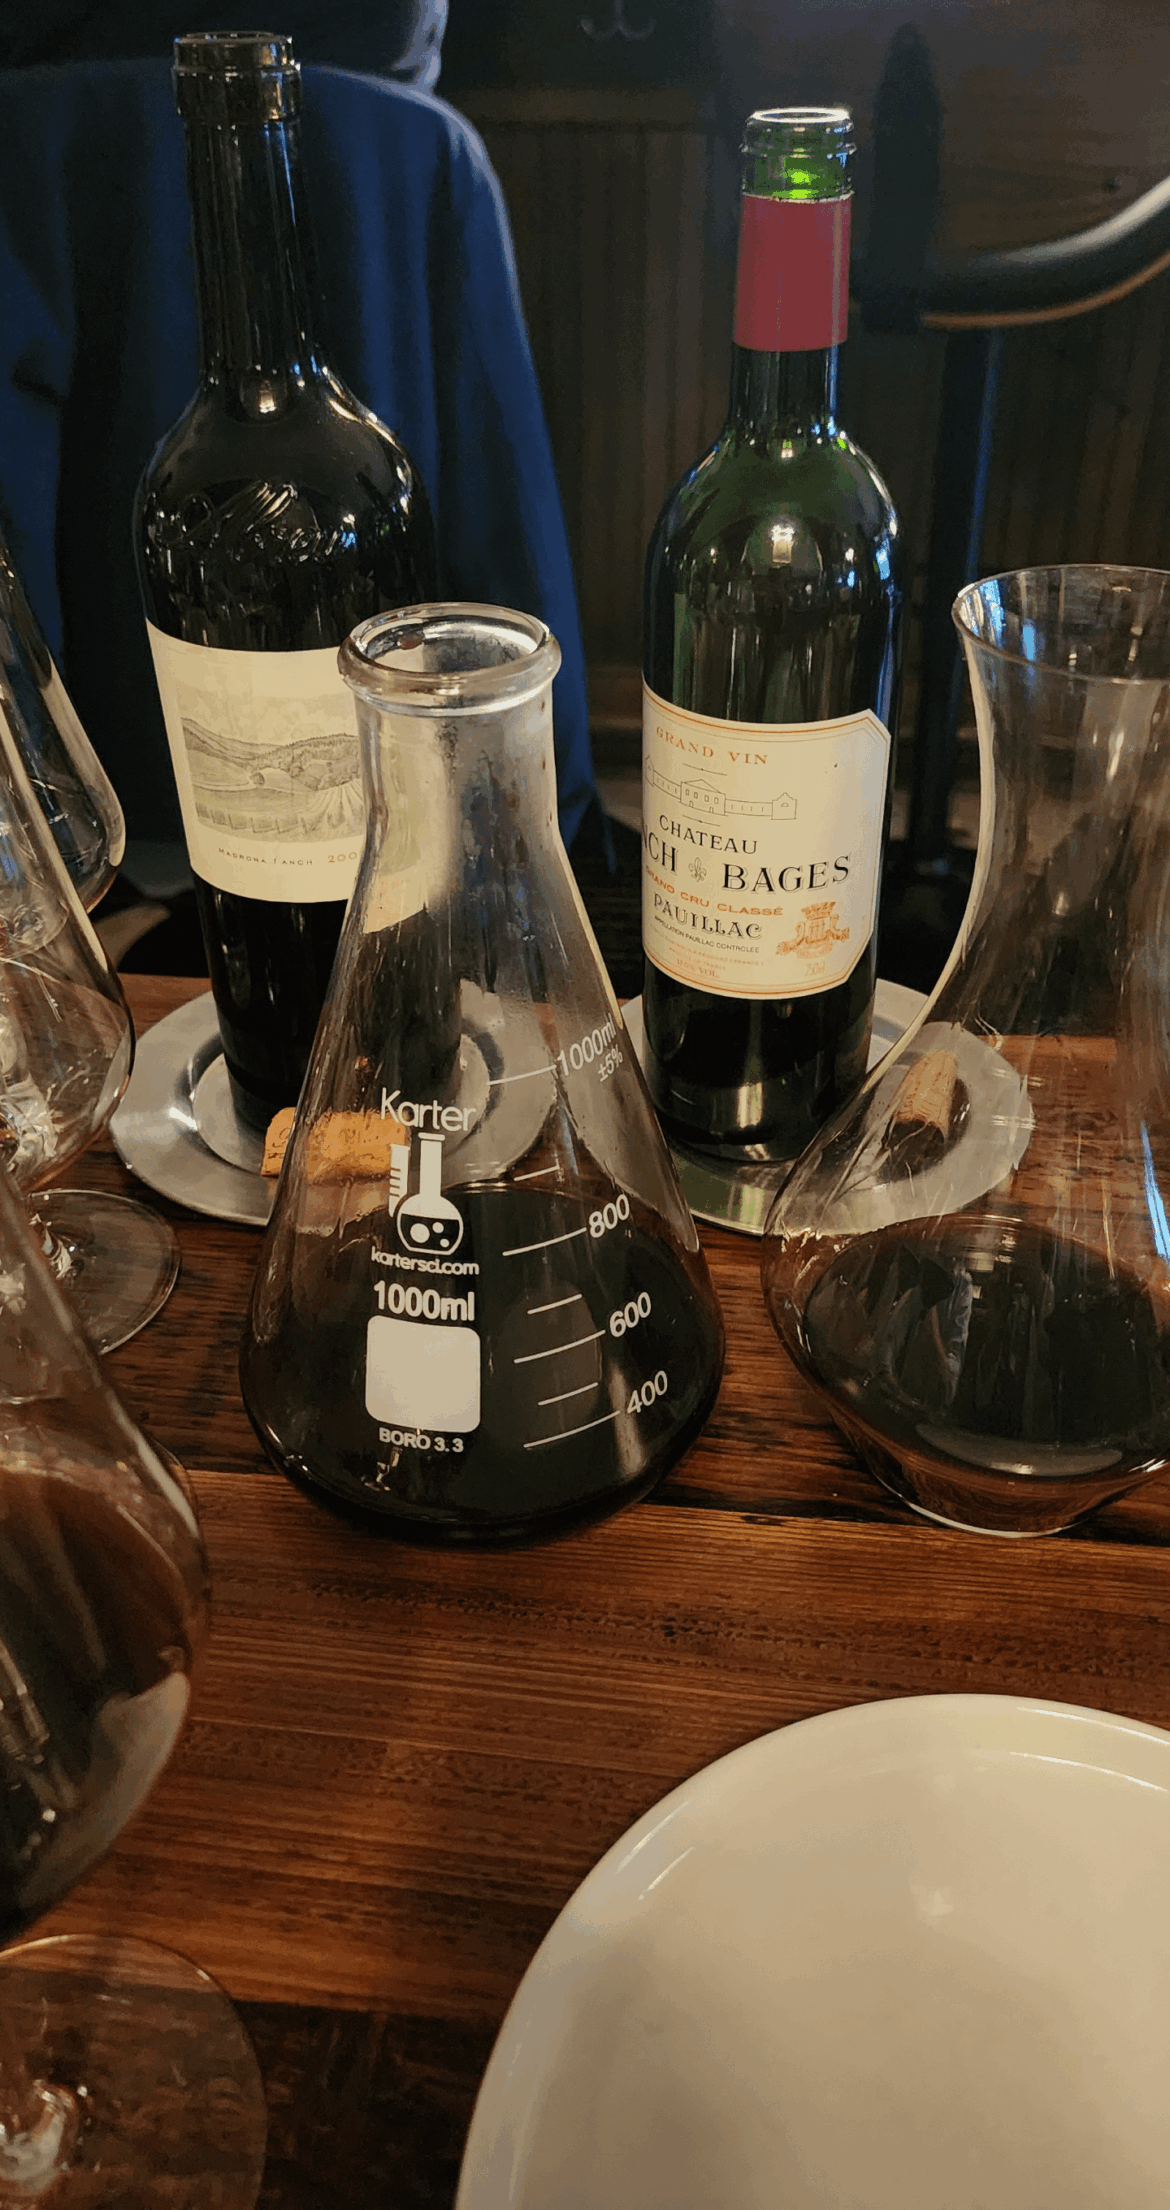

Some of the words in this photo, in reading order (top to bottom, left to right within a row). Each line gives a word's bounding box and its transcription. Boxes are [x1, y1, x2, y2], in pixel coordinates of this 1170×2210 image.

[656, 725, 714, 758] GRAND
[728, 750, 768, 766] VIN
[659, 814, 758, 855] CHATEAU
[327, 851, 361, 864] 200
[722, 854, 852, 893] BAGES
[654, 893, 763, 940] PAUILLAC
[680, 891, 710, 908] CRU
[557, 1012, 617, 1077] 1000ml
[598, 1044, 624, 1083] ±5%
[380, 1087, 478, 1133] Karter
[589, 1194, 631, 1240] 800
[371, 1245, 480, 1276] kartersci.com
[373, 1280, 476, 1322] 1000ml
[609, 1291, 652, 1339] 600
[627, 1370, 668, 1415] 400
[379, 1427, 430, 1450] BORO
